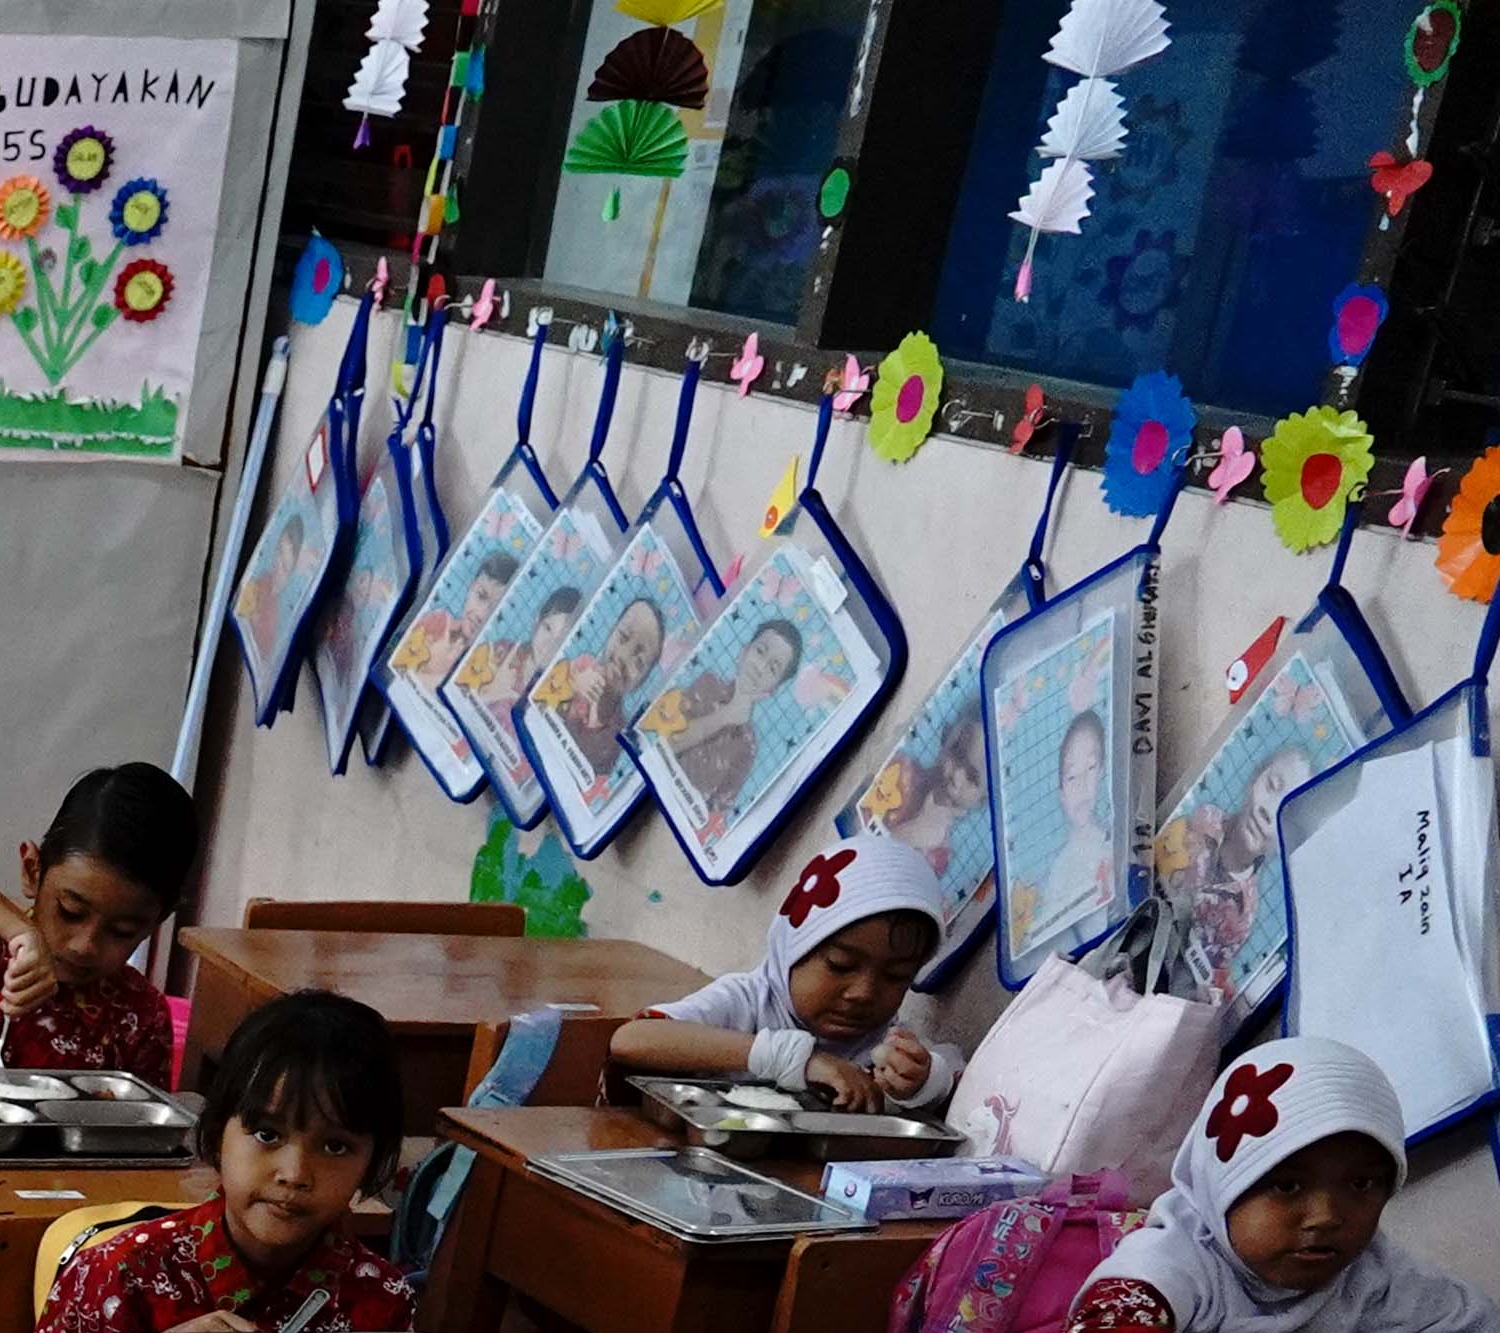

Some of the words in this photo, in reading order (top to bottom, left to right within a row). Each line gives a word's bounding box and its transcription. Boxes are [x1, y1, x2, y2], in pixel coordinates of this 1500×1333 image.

[3, 129, 46, 161] 5S
[1136, 650, 1153, 678] AL
[1132, 694, 1154, 754] DAVI
